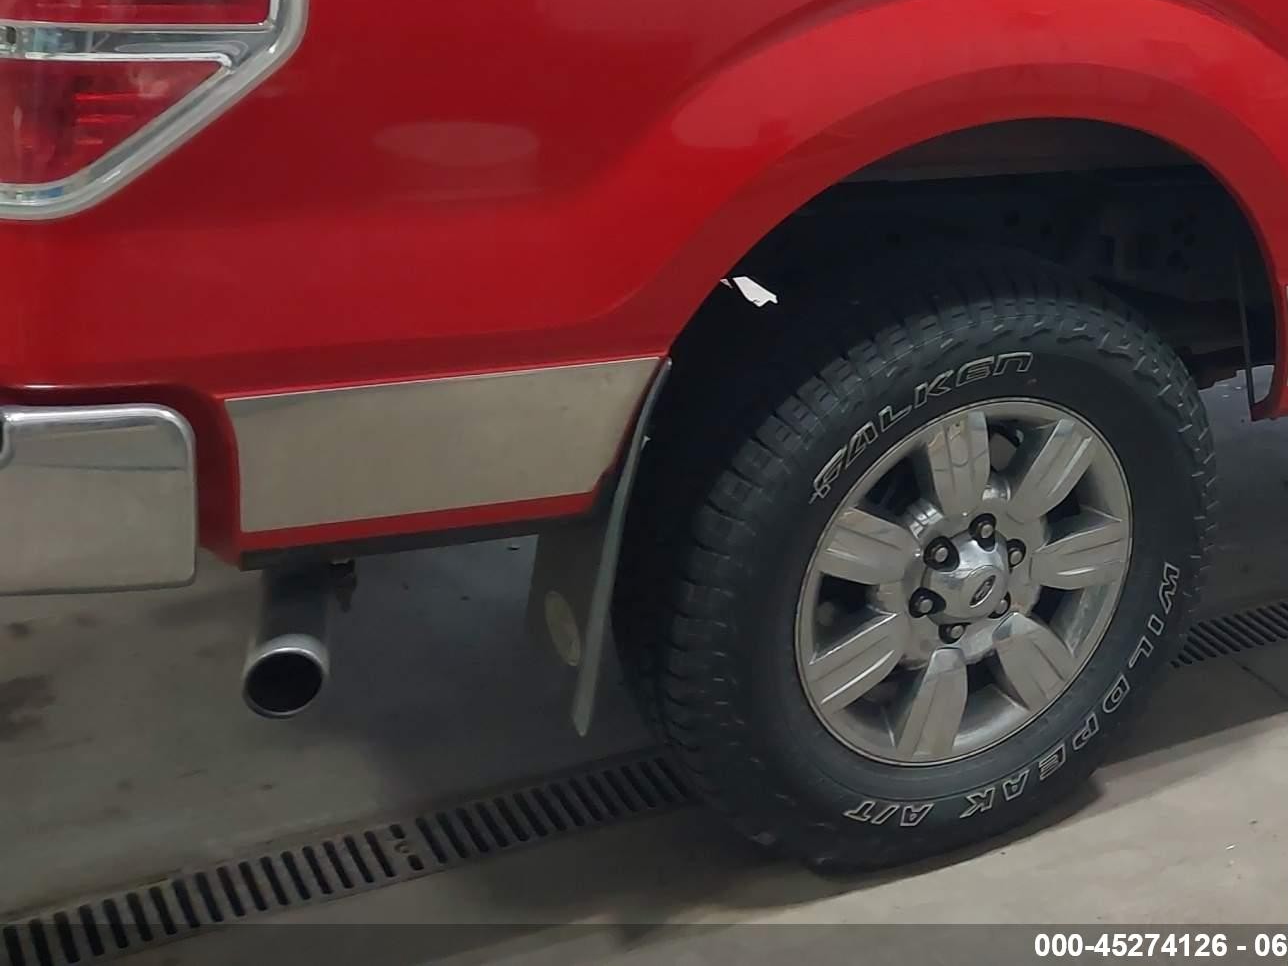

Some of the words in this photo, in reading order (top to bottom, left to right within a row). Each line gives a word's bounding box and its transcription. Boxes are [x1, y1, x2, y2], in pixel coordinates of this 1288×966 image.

[808, 351, 1034, 504] FALKEN
[959, 562, 1180, 819] WILDPEAK
[844, 799, 935, 827] A/T
